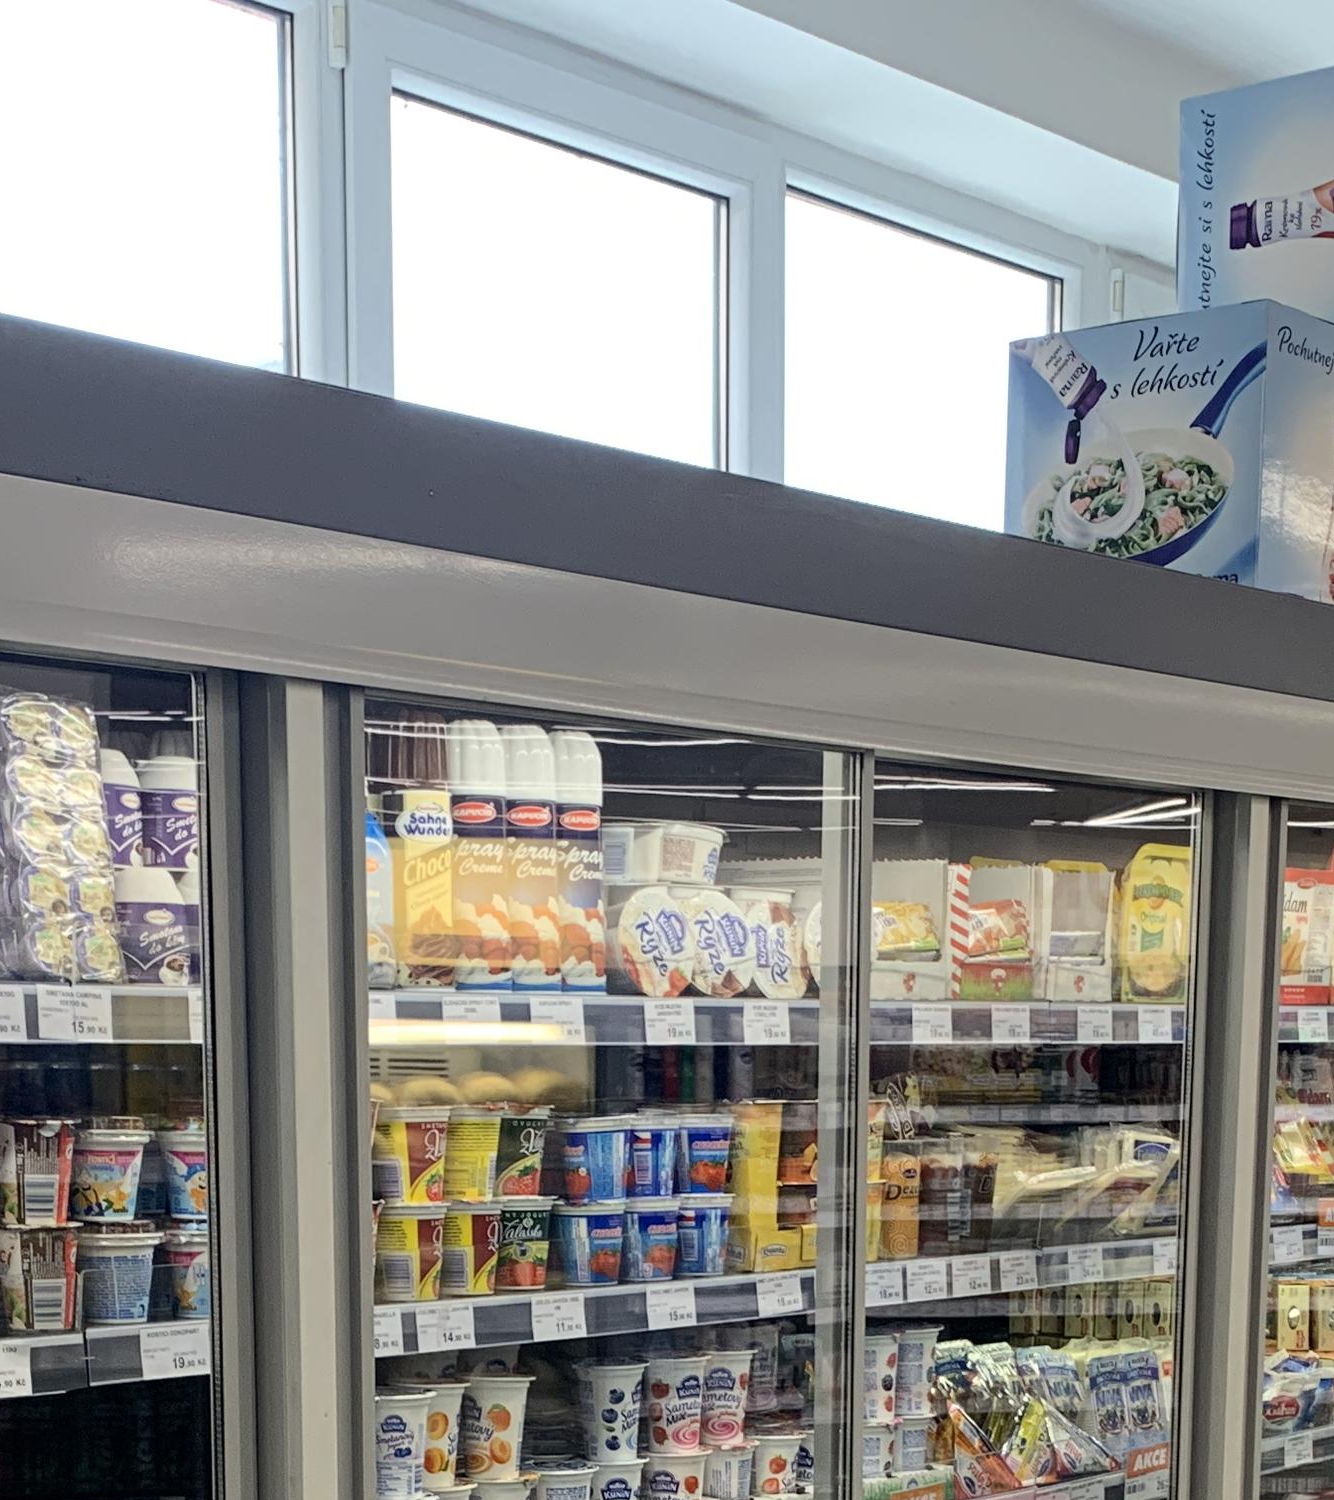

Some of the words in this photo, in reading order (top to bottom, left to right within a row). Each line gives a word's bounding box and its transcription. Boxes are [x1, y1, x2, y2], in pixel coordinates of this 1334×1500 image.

[1196, 109, 1217, 192] lehkostí
[1206, 201, 1213, 210] s
[1262, 200, 1273, 242] Rama
[1202, 216, 1212, 236] si
[1133, 326, 1201, 362] Vařte
[1110, 383, 1122, 400] s
[1131, 358, 1224, 398] lehkostí
[409, 812, 448, 826] Sahne
[403, 850, 452, 887] Choco
